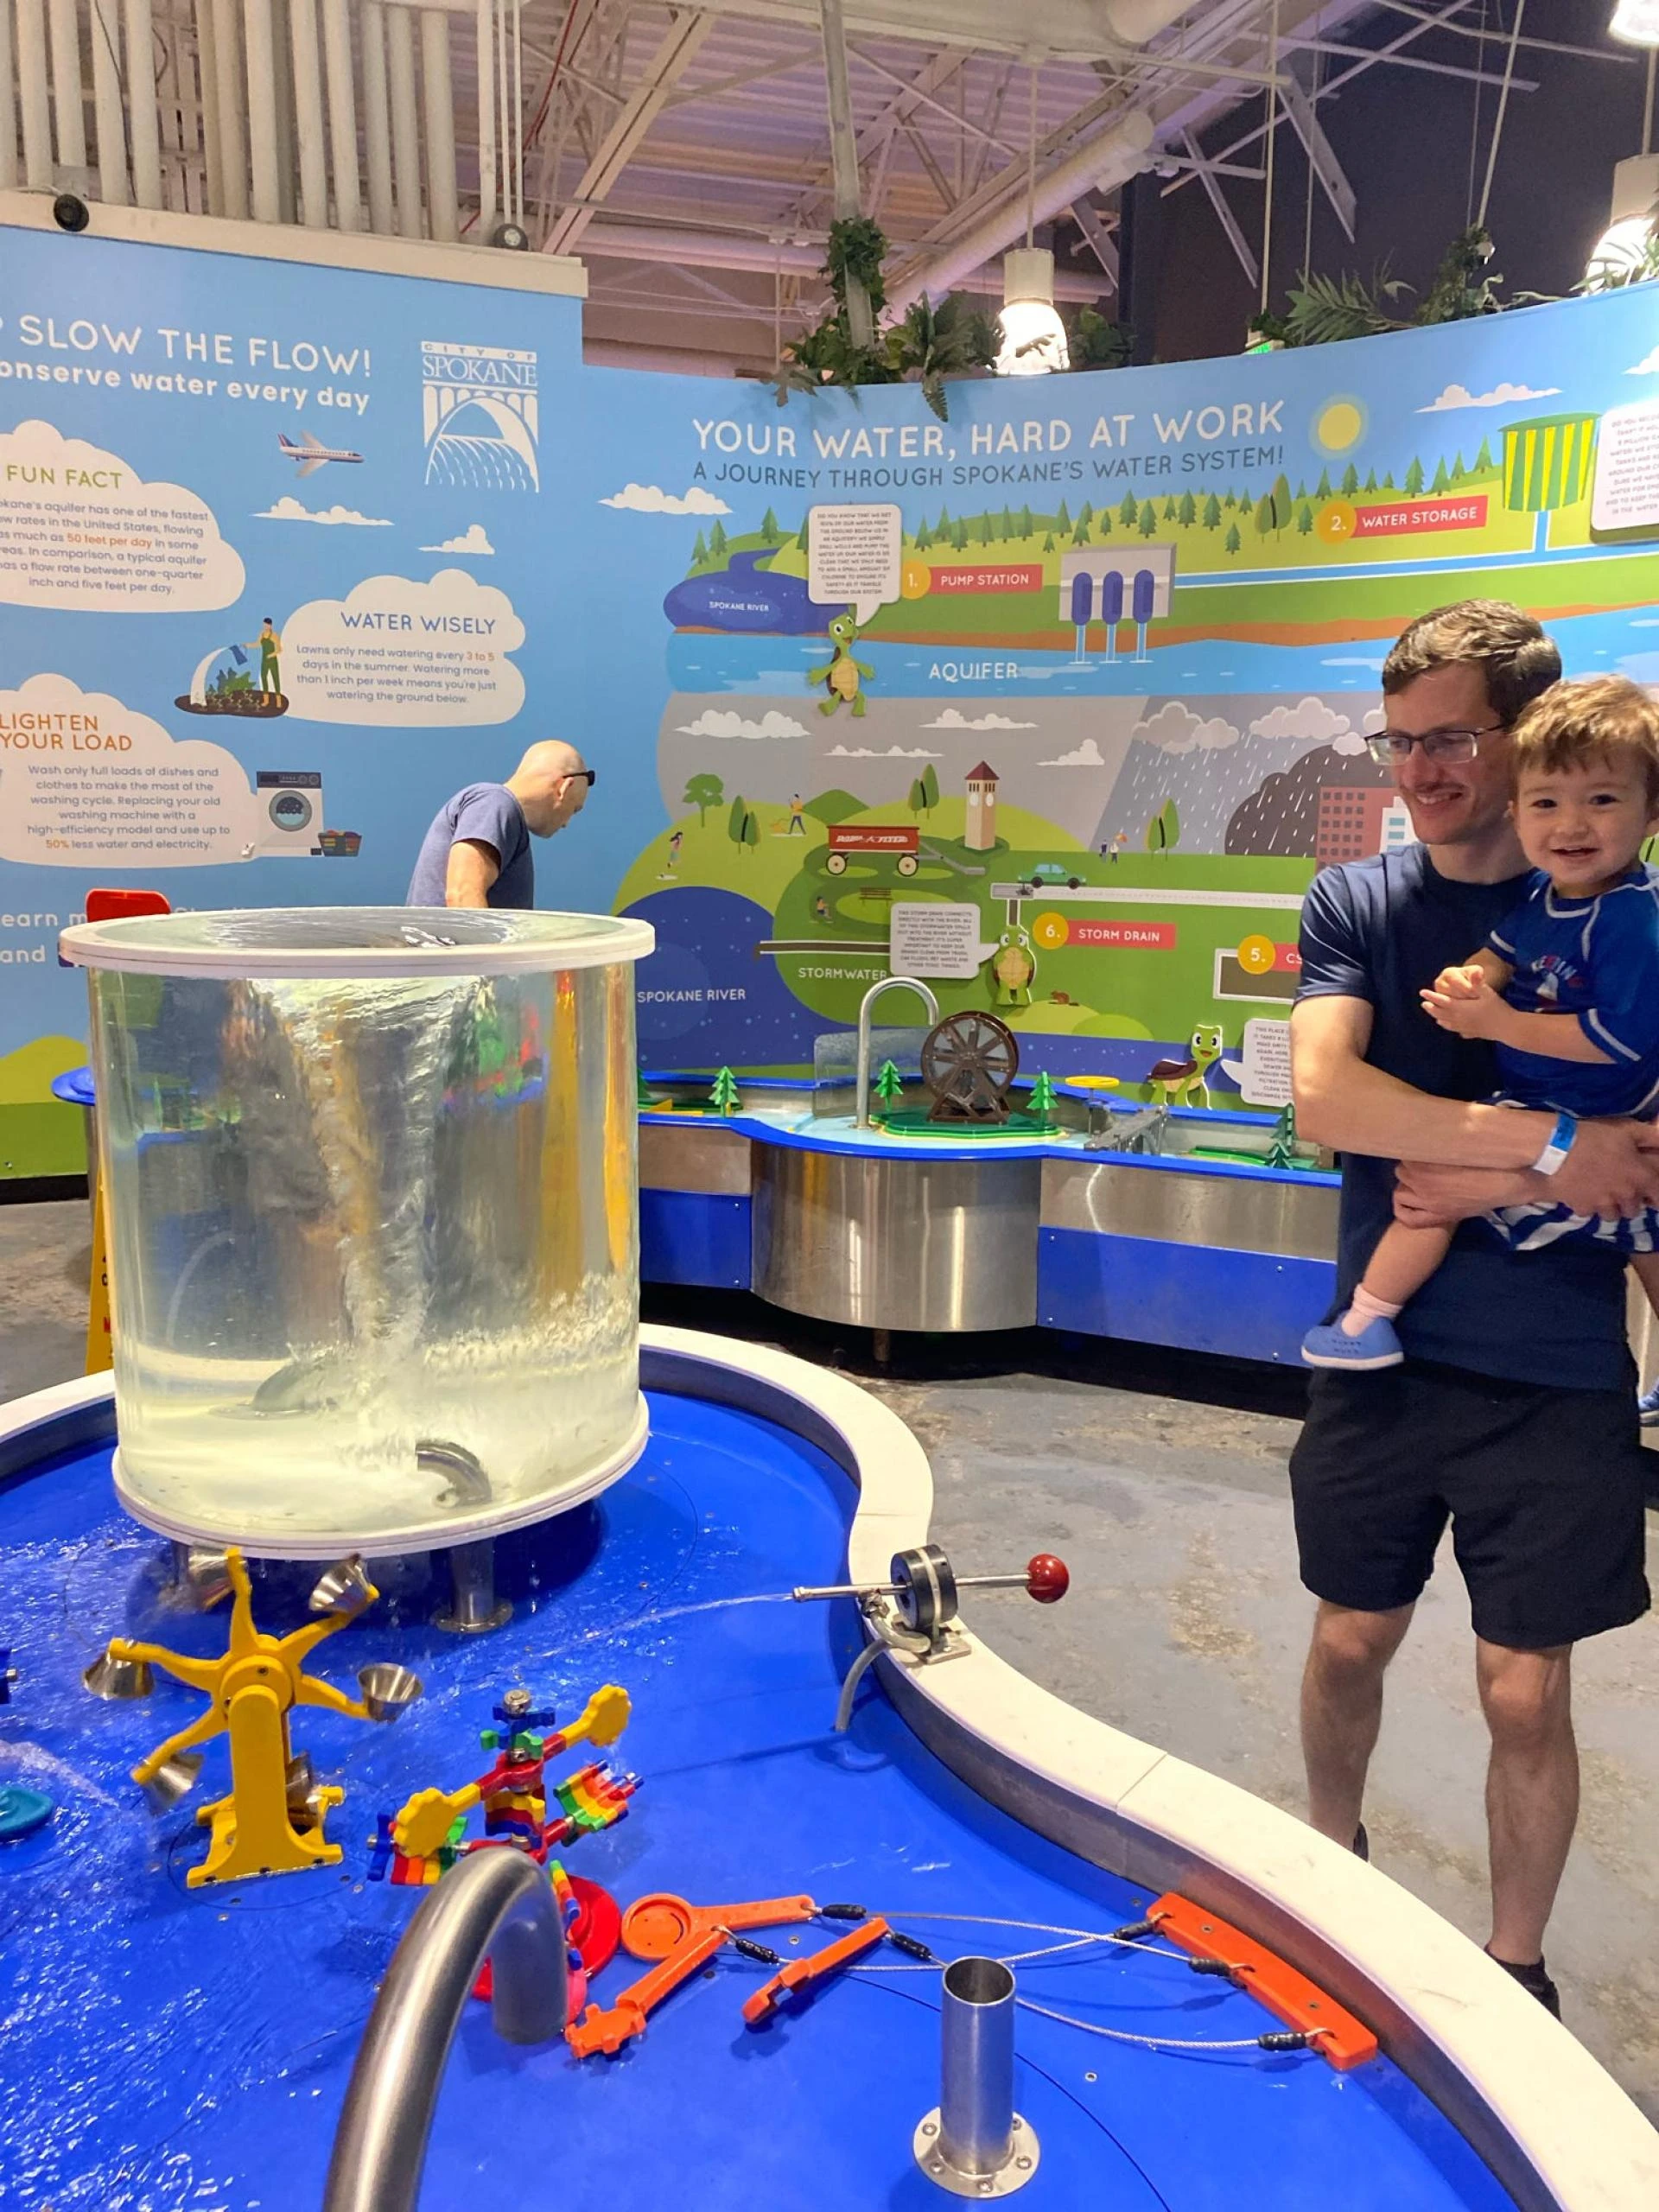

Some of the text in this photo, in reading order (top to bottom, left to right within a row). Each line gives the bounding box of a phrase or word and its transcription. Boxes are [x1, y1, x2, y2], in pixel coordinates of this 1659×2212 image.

[20, 315, 370, 378] SLOW THE FLOW!
[425, 344, 485, 356] CITY
[423, 355, 537, 386] SPOKANE
[130, 371, 217, 396] water
[227, 381, 308, 410] every
[317, 386, 370, 416] day
[692, 399, 1284, 461] YOUR WATER, HARD AT WORK
[694, 445, 1283, 488] A JOURNEY THROUGH SPOKANE'S WATER SYSTEM!
[7, 465, 122, 489] FUN FACT
[45, 502, 86, 513] aquifer
[89, 505, 110, 514] has
[113, 507, 134, 516] one
[137, 507, 147, 516] of
[151, 509, 168, 518] the
[172, 511, 207, 521] fastest
[1331, 506, 1477, 531] 2. WATER STORAGE
[16, 517, 45, 525] rates
[62, 518, 80, 528] the
[86, 519, 120, 531] United
[124, 522, 161, 534] States,
[164, 524, 203, 538] flowing
[14, 531, 47, 541] much
[67, 533, 81, 543] 50
[86, 535, 106, 544] feet
[110, 537, 127, 547] per
[130, 538, 151, 550] day
[156, 539, 165, 549] in
[29, 547, 39, 556] In
[127, 553, 165, 565] typical
[168, 556, 207, 566] aquifer
[31, 563, 54, 572] flow
[58, 563, 80, 573] rate
[84, 565, 131, 576] between
[136, 568, 203, 580] one-quarter
[29, 577, 53, 587] inch
[56, 579, 79, 588] and
[82, 580, 101, 589] five
[105, 581, 126, 590] feet
[130, 584, 147, 594] per
[909, 573, 1029, 588] 1. PUMP STATION
[340, 612, 496, 634] WATER WISELY
[297, 645, 329, 654] Lawns
[333, 646, 355, 657] only
[359, 648, 385, 657] need
[388, 649, 432, 661] watering
[436, 652, 464, 661] every
[467, 652, 473, 660] 3
[488, 652, 494, 661] 5
[302, 660, 329, 671] days
[333, 661, 340, 670] in
[345, 660, 361, 671] the
[414, 664, 460, 677] Watering
[463, 667, 490, 676] more
[929, 662, 1018, 683] AQUIFER
[297, 675, 321, 683] than
[331, 676, 353, 685] inch
[358, 677, 373, 687] per
[377, 677, 403, 687] week
[407, 680, 442, 689] means
[478, 682, 496, 691] just
[327, 691, 373, 702] watering
[377, 692, 395, 702] the
[397, 694, 433, 703] ground
[0, 713, 98, 731] LIGHTEN
[0, 732, 131, 751] YOUR LOAD
[29, 766, 219, 777] Wash only full loads of dishes and
[36, 780, 213, 791] clothes to make the most of the
[30, 795, 79, 807] washing
[118, 796, 173, 808] Replacing
[176, 798, 201, 808] your
[204, 797, 220, 806] old
[59, 810, 107, 822] washing
[110, 810, 159, 820] machine
[162, 810, 185, 820] with
[117, 825, 152, 835] model
[156, 825, 177, 835] and
[202, 827, 216, 837] up
[219, 826, 230, 835] to
[46, 839, 69, 849] 50%
[72, 840, 93, 849] less
[97, 841, 128, 849] water
[130, 839, 153, 849] and
[2, 912, 58, 927] earn
[1046, 925, 1160, 941] 6. STORM DRAIN
[1, 946, 45, 963] and
[1251, 948, 1266, 962] 5.
[798, 968, 887, 981] STORMWATER
[638, 988, 746, 1003] SPOKANE RIVER
